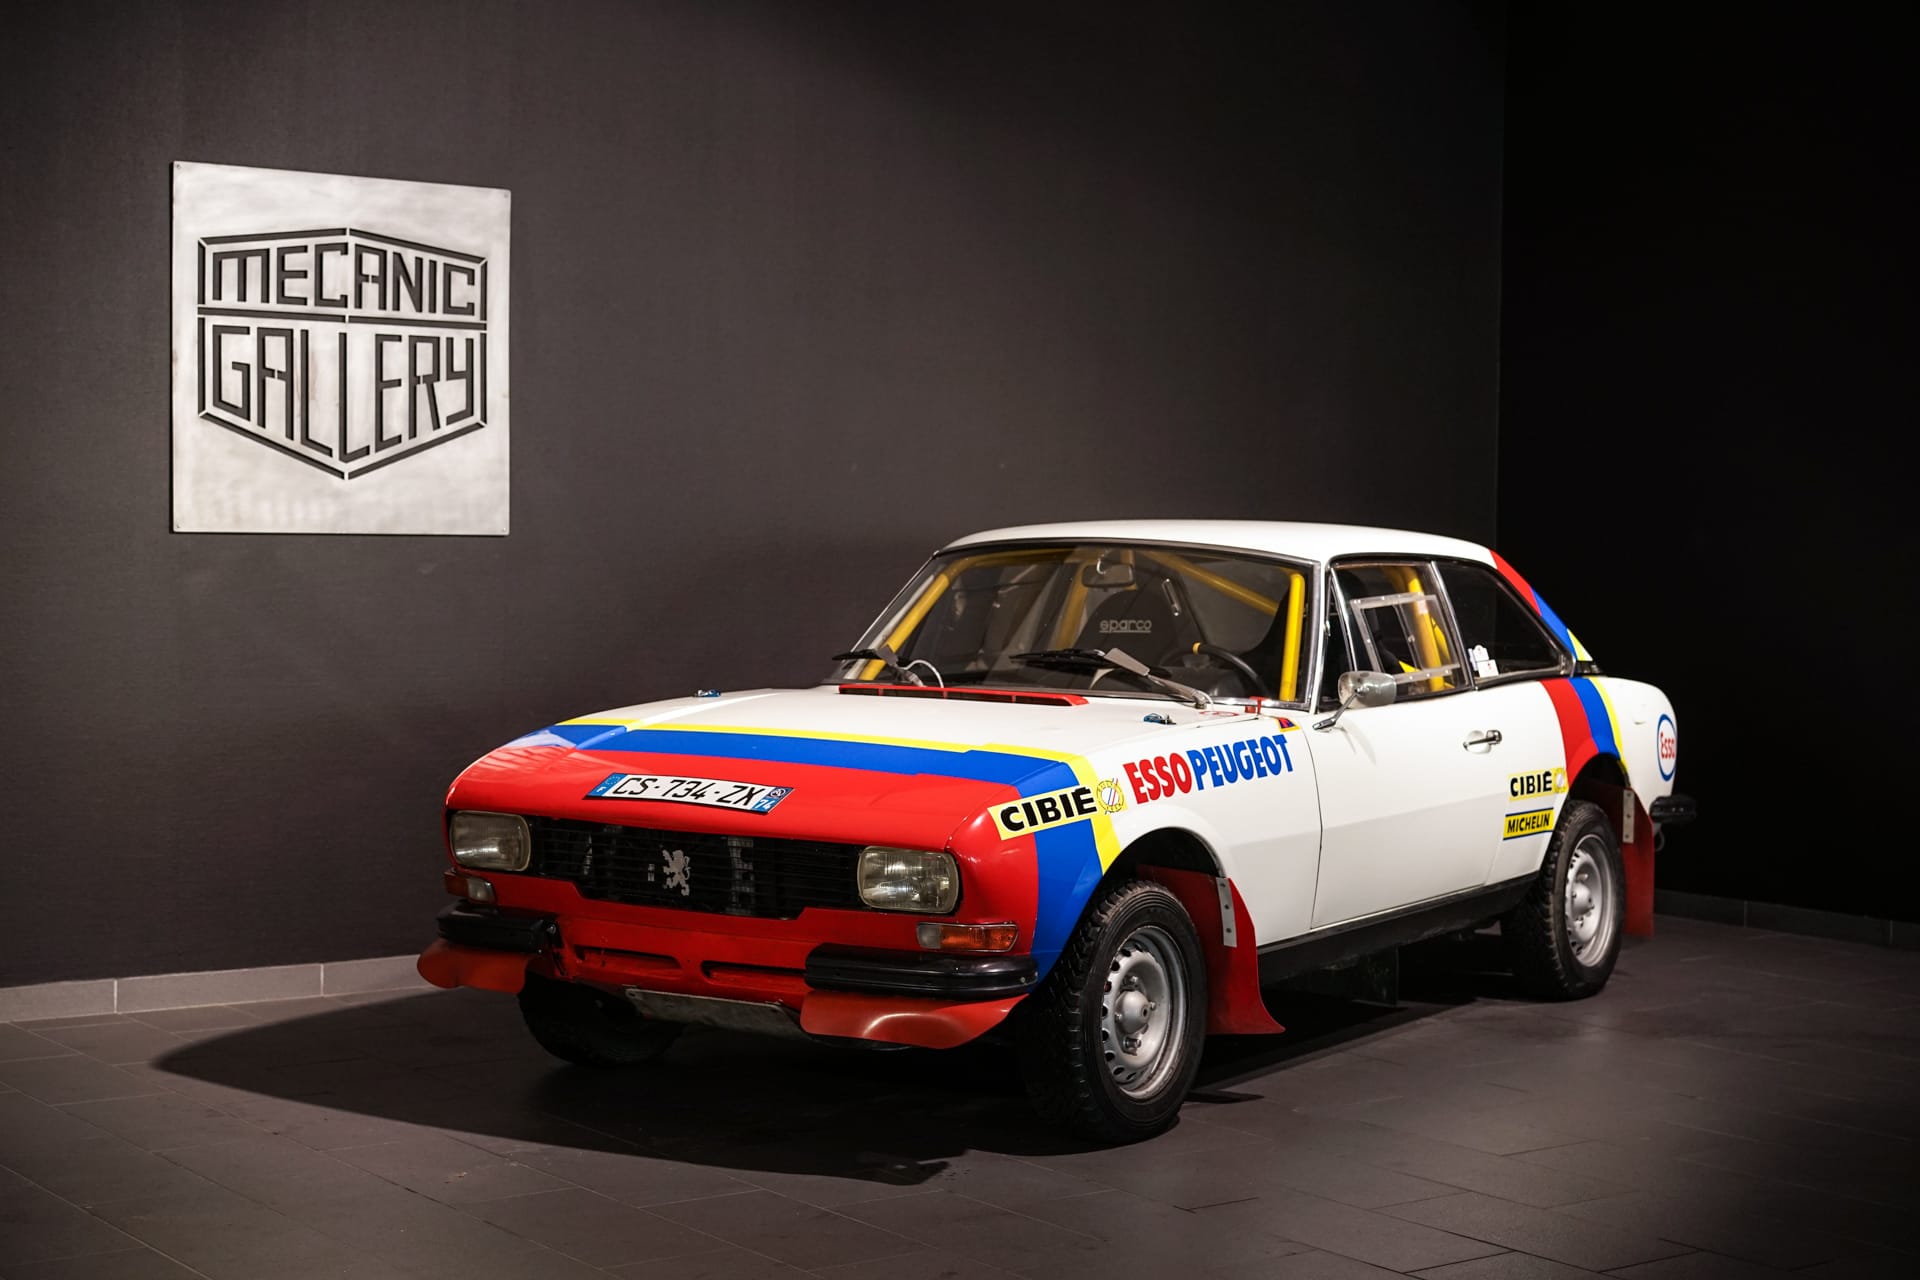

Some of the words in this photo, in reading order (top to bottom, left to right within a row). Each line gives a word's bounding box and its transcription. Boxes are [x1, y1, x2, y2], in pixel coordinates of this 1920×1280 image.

[212, 242, 475, 316] MECANIC
[212, 324, 474, 463] GALLERY
[1100, 619, 1152, 632] sparco
[1123, 752, 1193, 804] ESSO
[1186, 734, 1293, 791] PEUGEOT
[1507, 812, 1550, 834] MICHELIN
